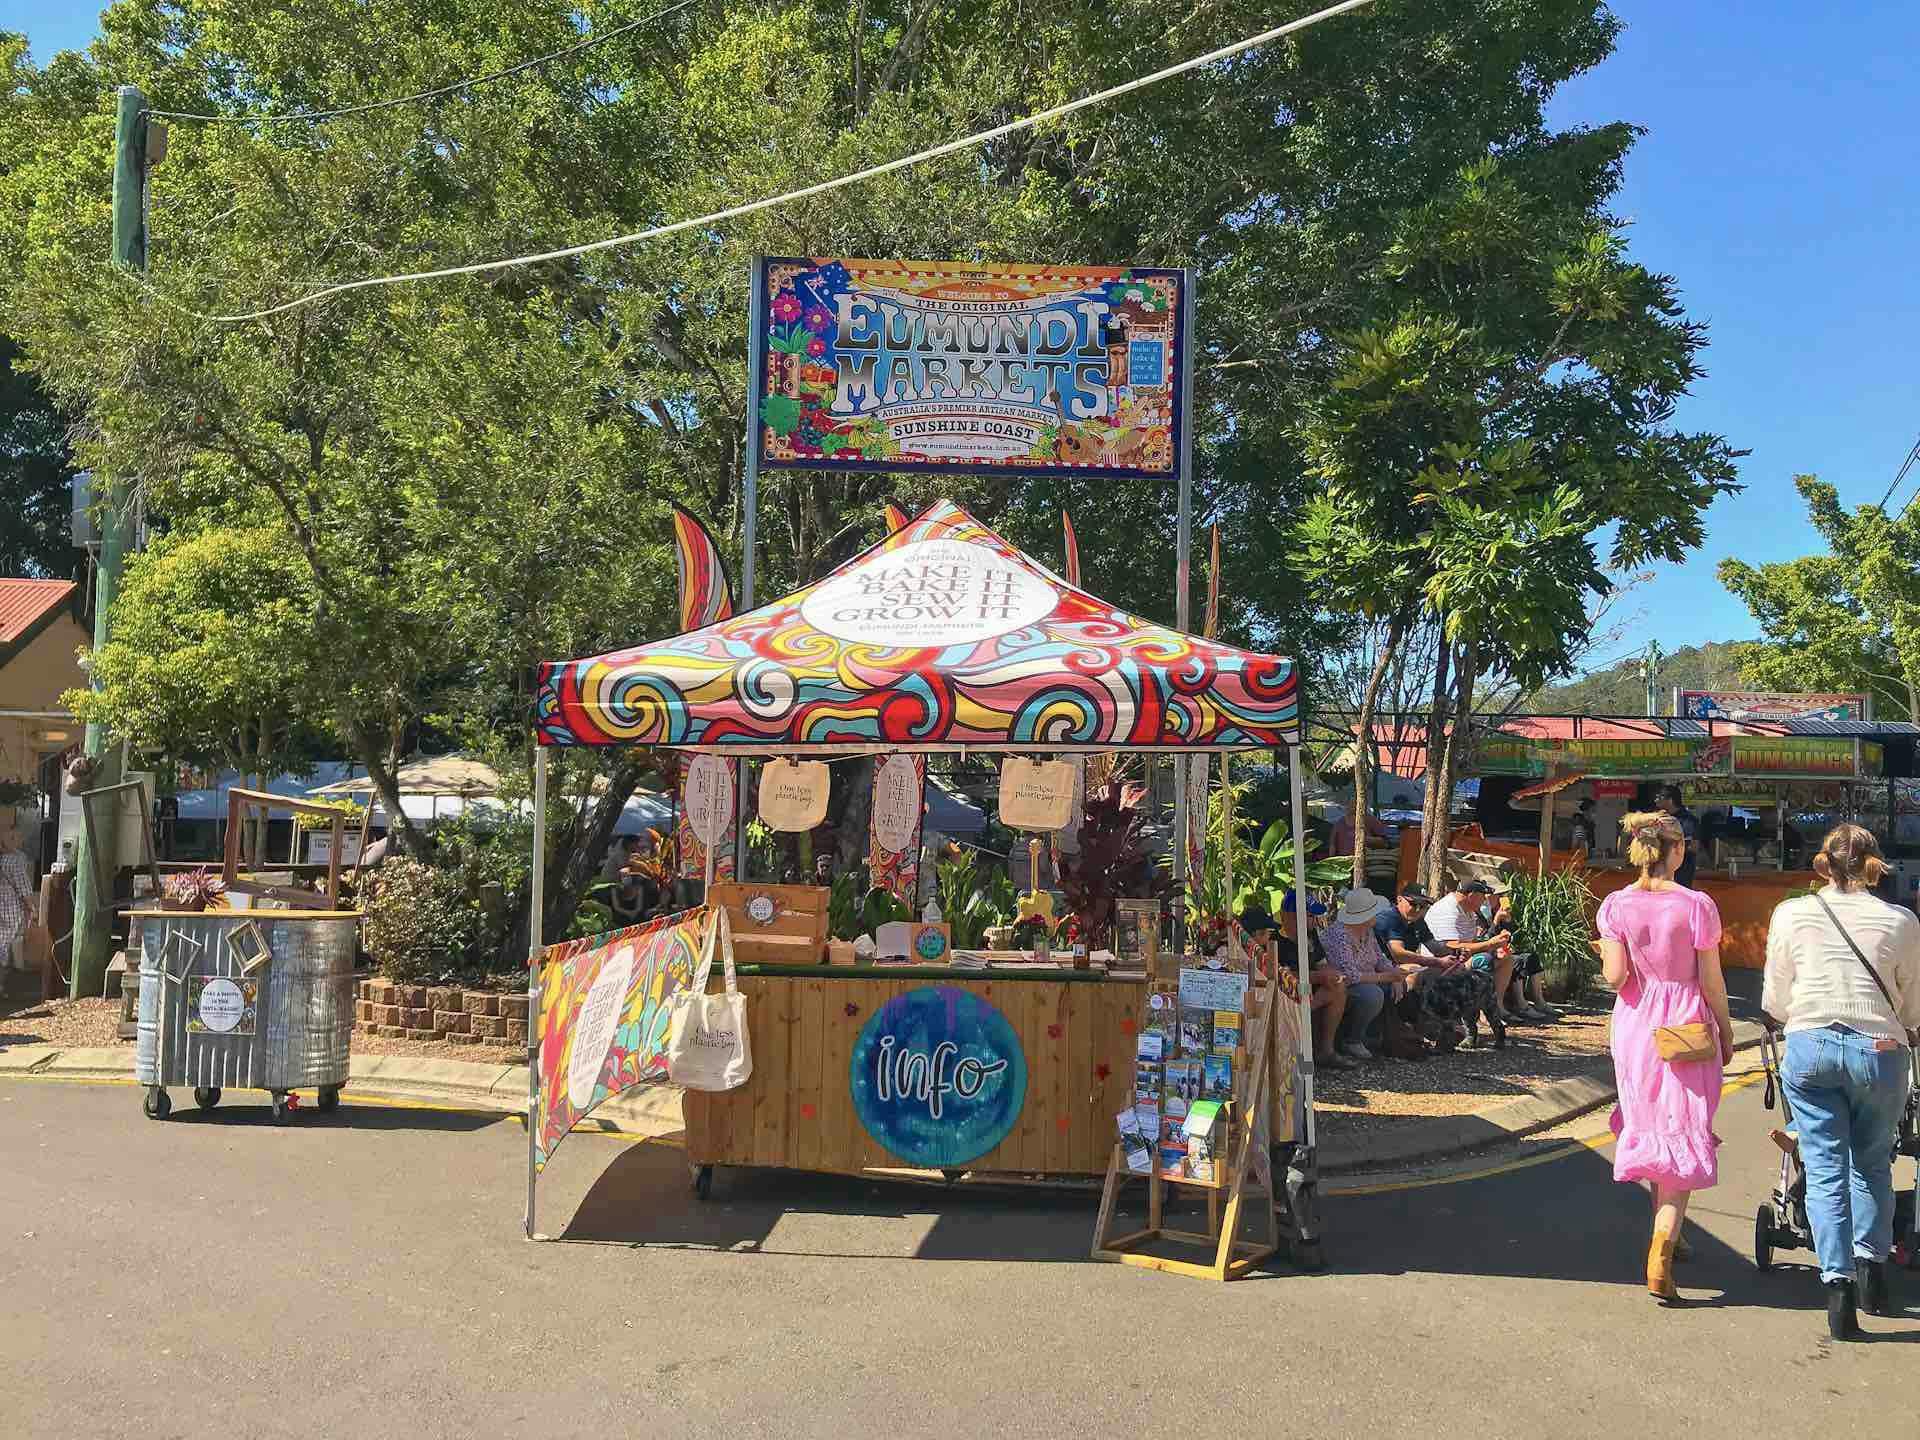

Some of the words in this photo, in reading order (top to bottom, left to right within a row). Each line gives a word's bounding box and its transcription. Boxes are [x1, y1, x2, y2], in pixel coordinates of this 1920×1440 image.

[916, 299, 946, 309] THE
[951, 300, 1029, 311] ORIGINAL
[833, 293, 1110, 357] EUMUNDI
[831, 354, 1109, 420] MARKETS
[881, 403, 938, 418] AUSTRALIA'S
[938, 403, 978, 413] PREMIER
[979, 405, 1019, 416] ARTISAN
[893, 420, 980, 437] SUNSHINE
[984, 423, 1034, 441] COAST
[858, 565, 972, 584] MAKE
[984, 568, 1018, 583] IT
[862, 578, 970, 597] BAKE
[982, 581, 1021, 594] IT
[880, 592, 968, 607] SEW
[977, 593, 1021, 606] IT
[831, 606, 964, 623] GROW
[975, 606, 1021, 619] IT
[877, 1035, 1009, 1120] info
